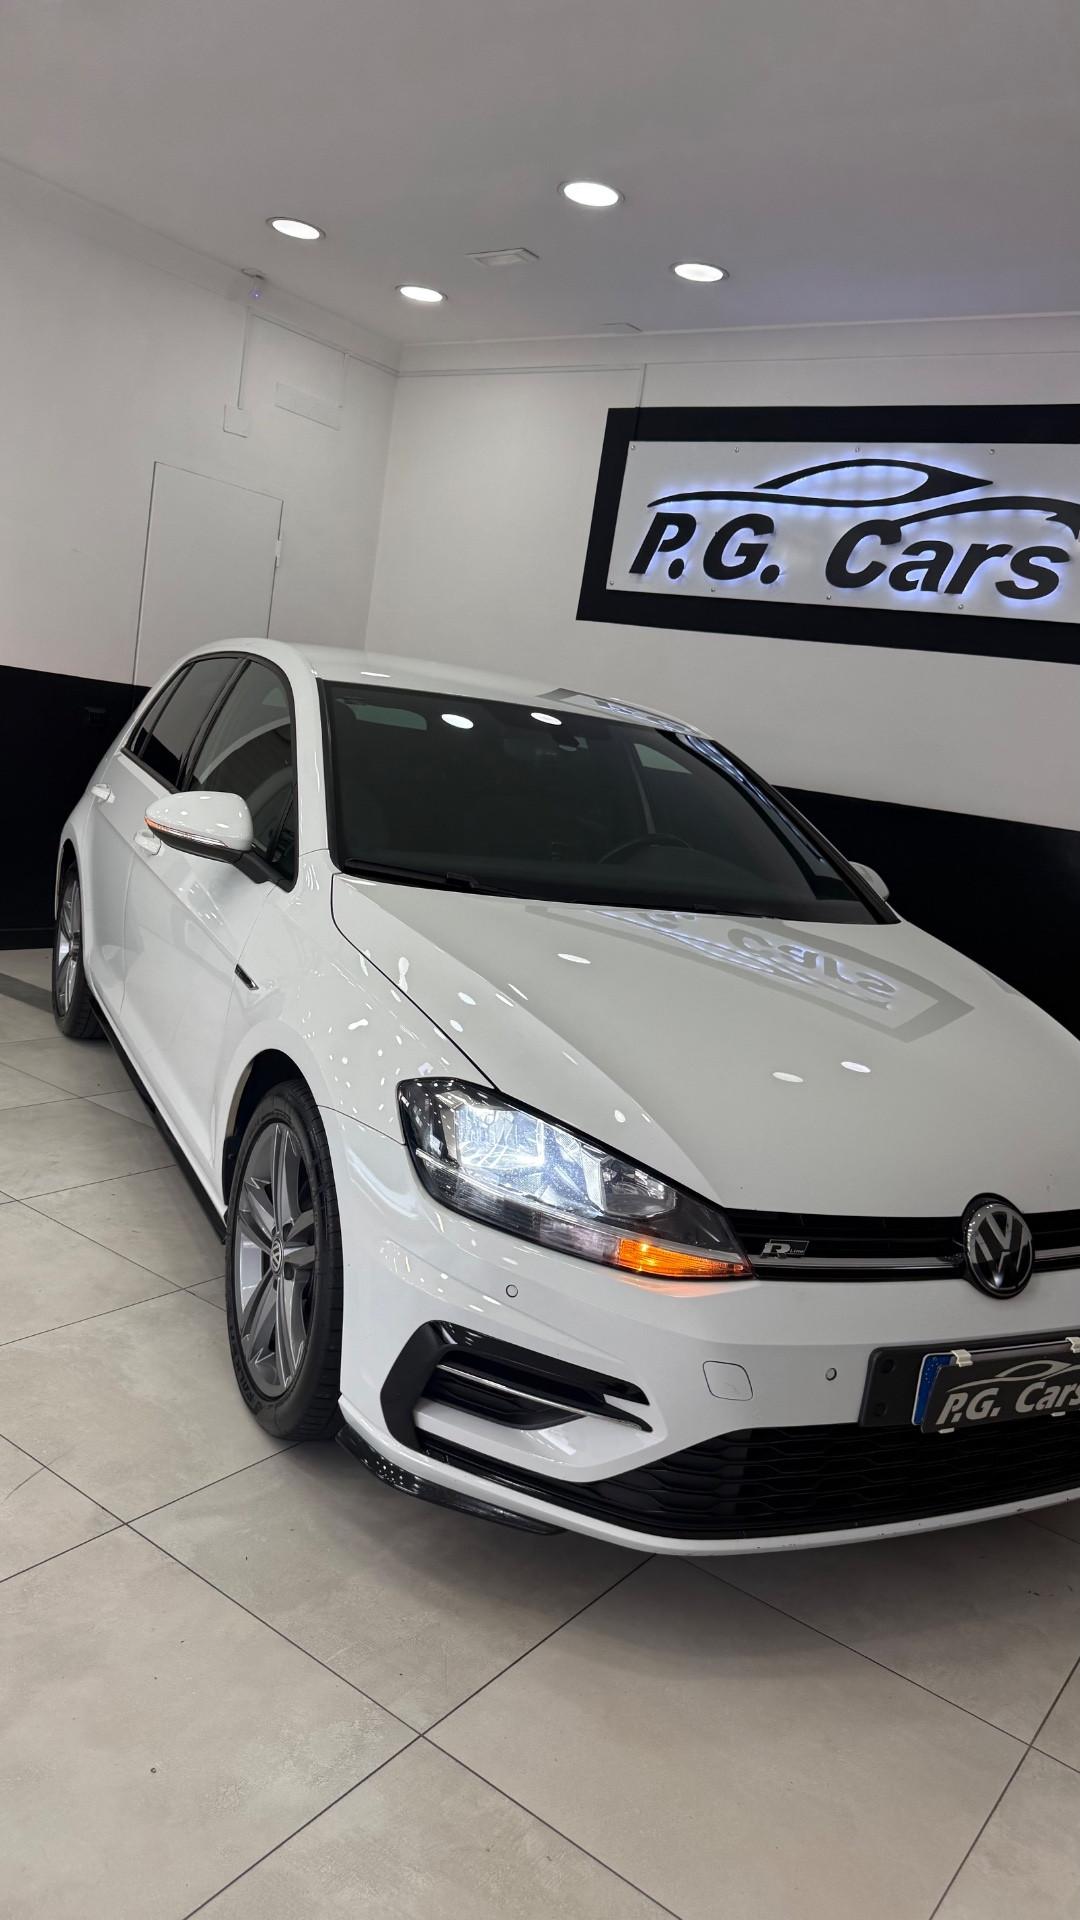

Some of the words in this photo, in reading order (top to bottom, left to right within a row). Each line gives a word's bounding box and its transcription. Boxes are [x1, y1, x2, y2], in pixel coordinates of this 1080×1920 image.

[629, 512, 780, 584] P.G.
[825, 519, 1070, 600] Cars
[935, 1387, 1001, 1425] P.G.
